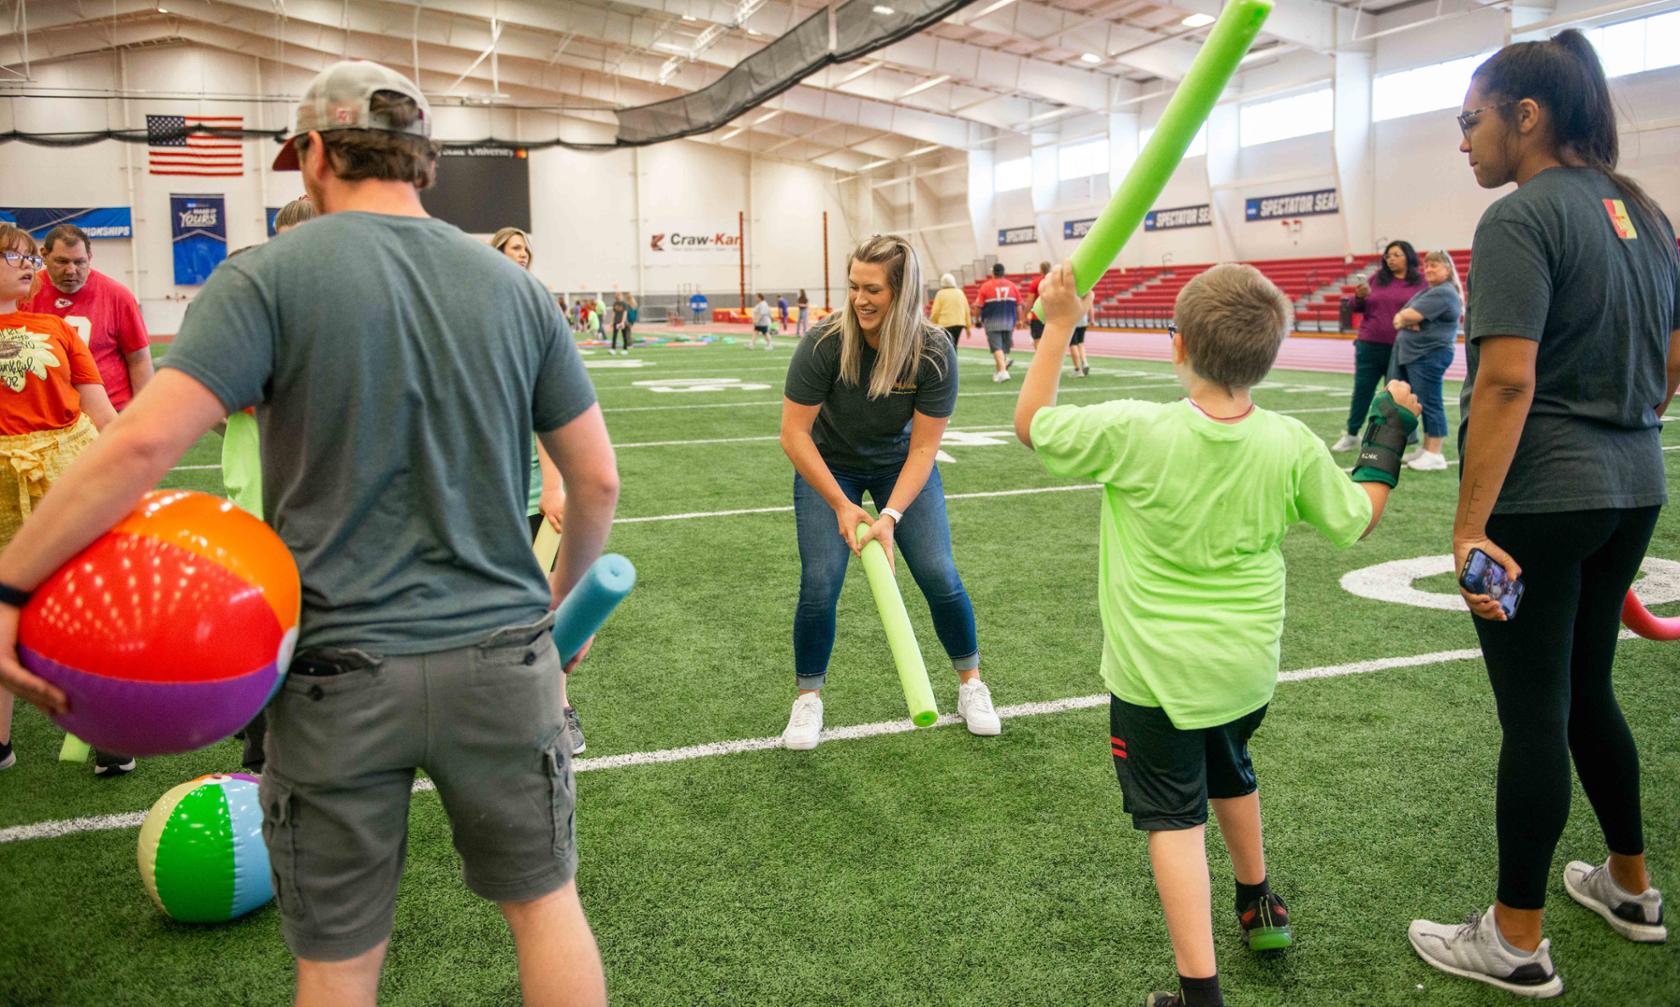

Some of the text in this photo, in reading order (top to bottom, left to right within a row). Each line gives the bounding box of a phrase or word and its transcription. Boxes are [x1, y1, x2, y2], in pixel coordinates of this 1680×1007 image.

[1260, 195, 1314, 217] SPECTATOR
[1156, 208, 1198, 227] SPECTATOR
[995, 287, 1009, 302] 17
